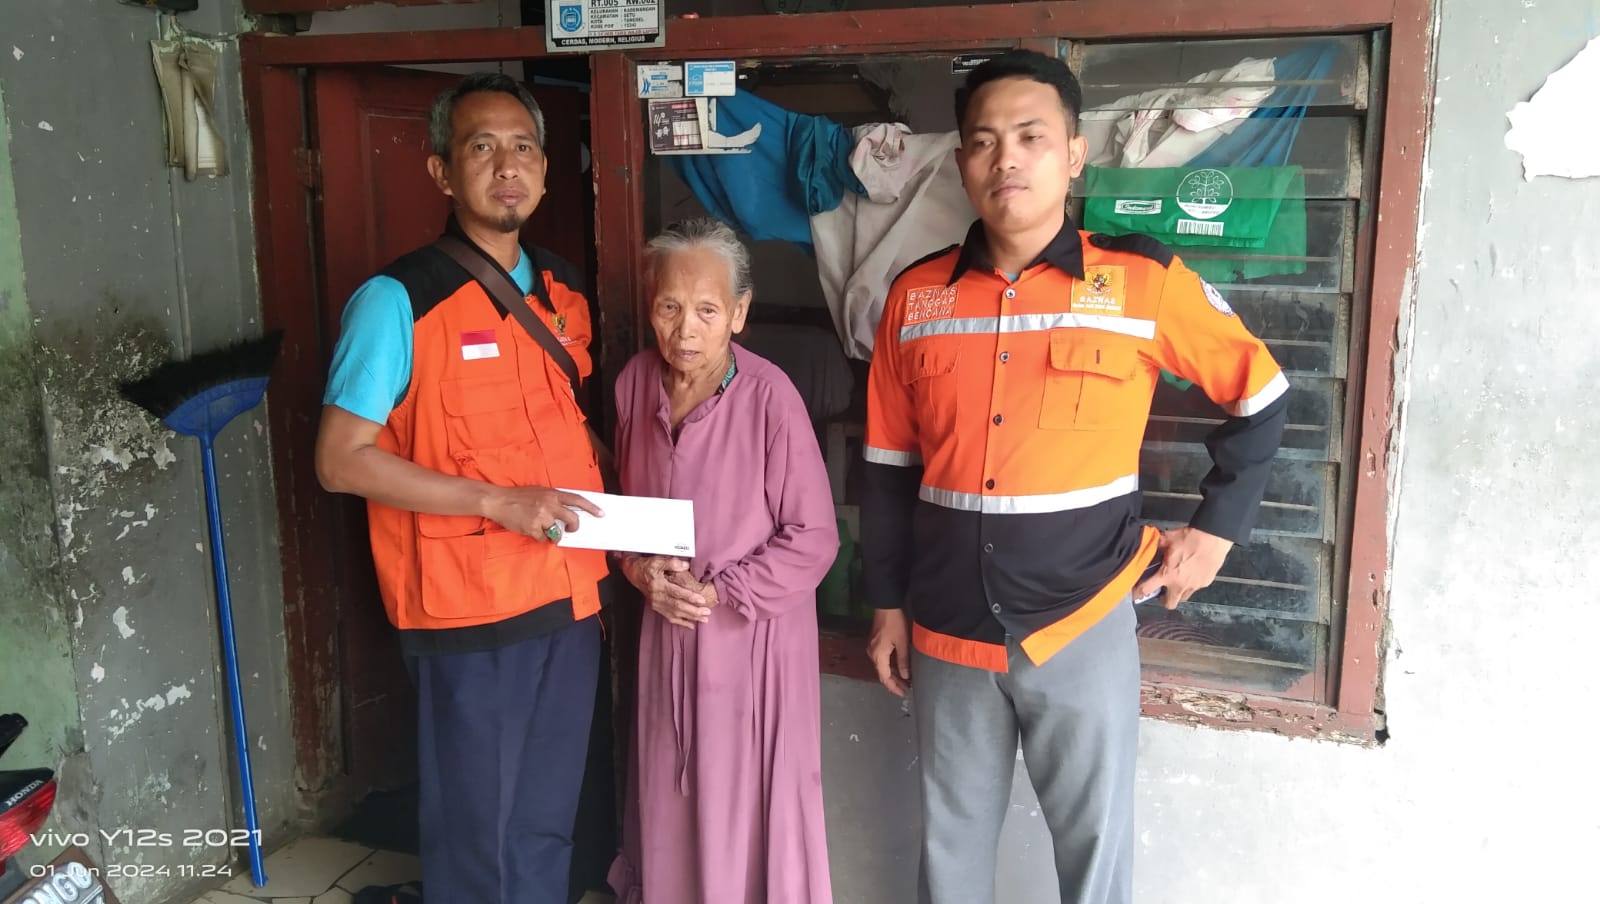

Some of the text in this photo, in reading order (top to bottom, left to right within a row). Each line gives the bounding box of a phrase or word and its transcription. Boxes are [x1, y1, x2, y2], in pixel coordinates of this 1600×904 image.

[617, 35, 646, 43] RELIGIUS
[909, 286, 957, 301] BAZNAS
[907, 297, 955, 311] TANGGAP
[907, 306, 953, 321] BENCANA
[5, 780, 44, 806] HONDA
